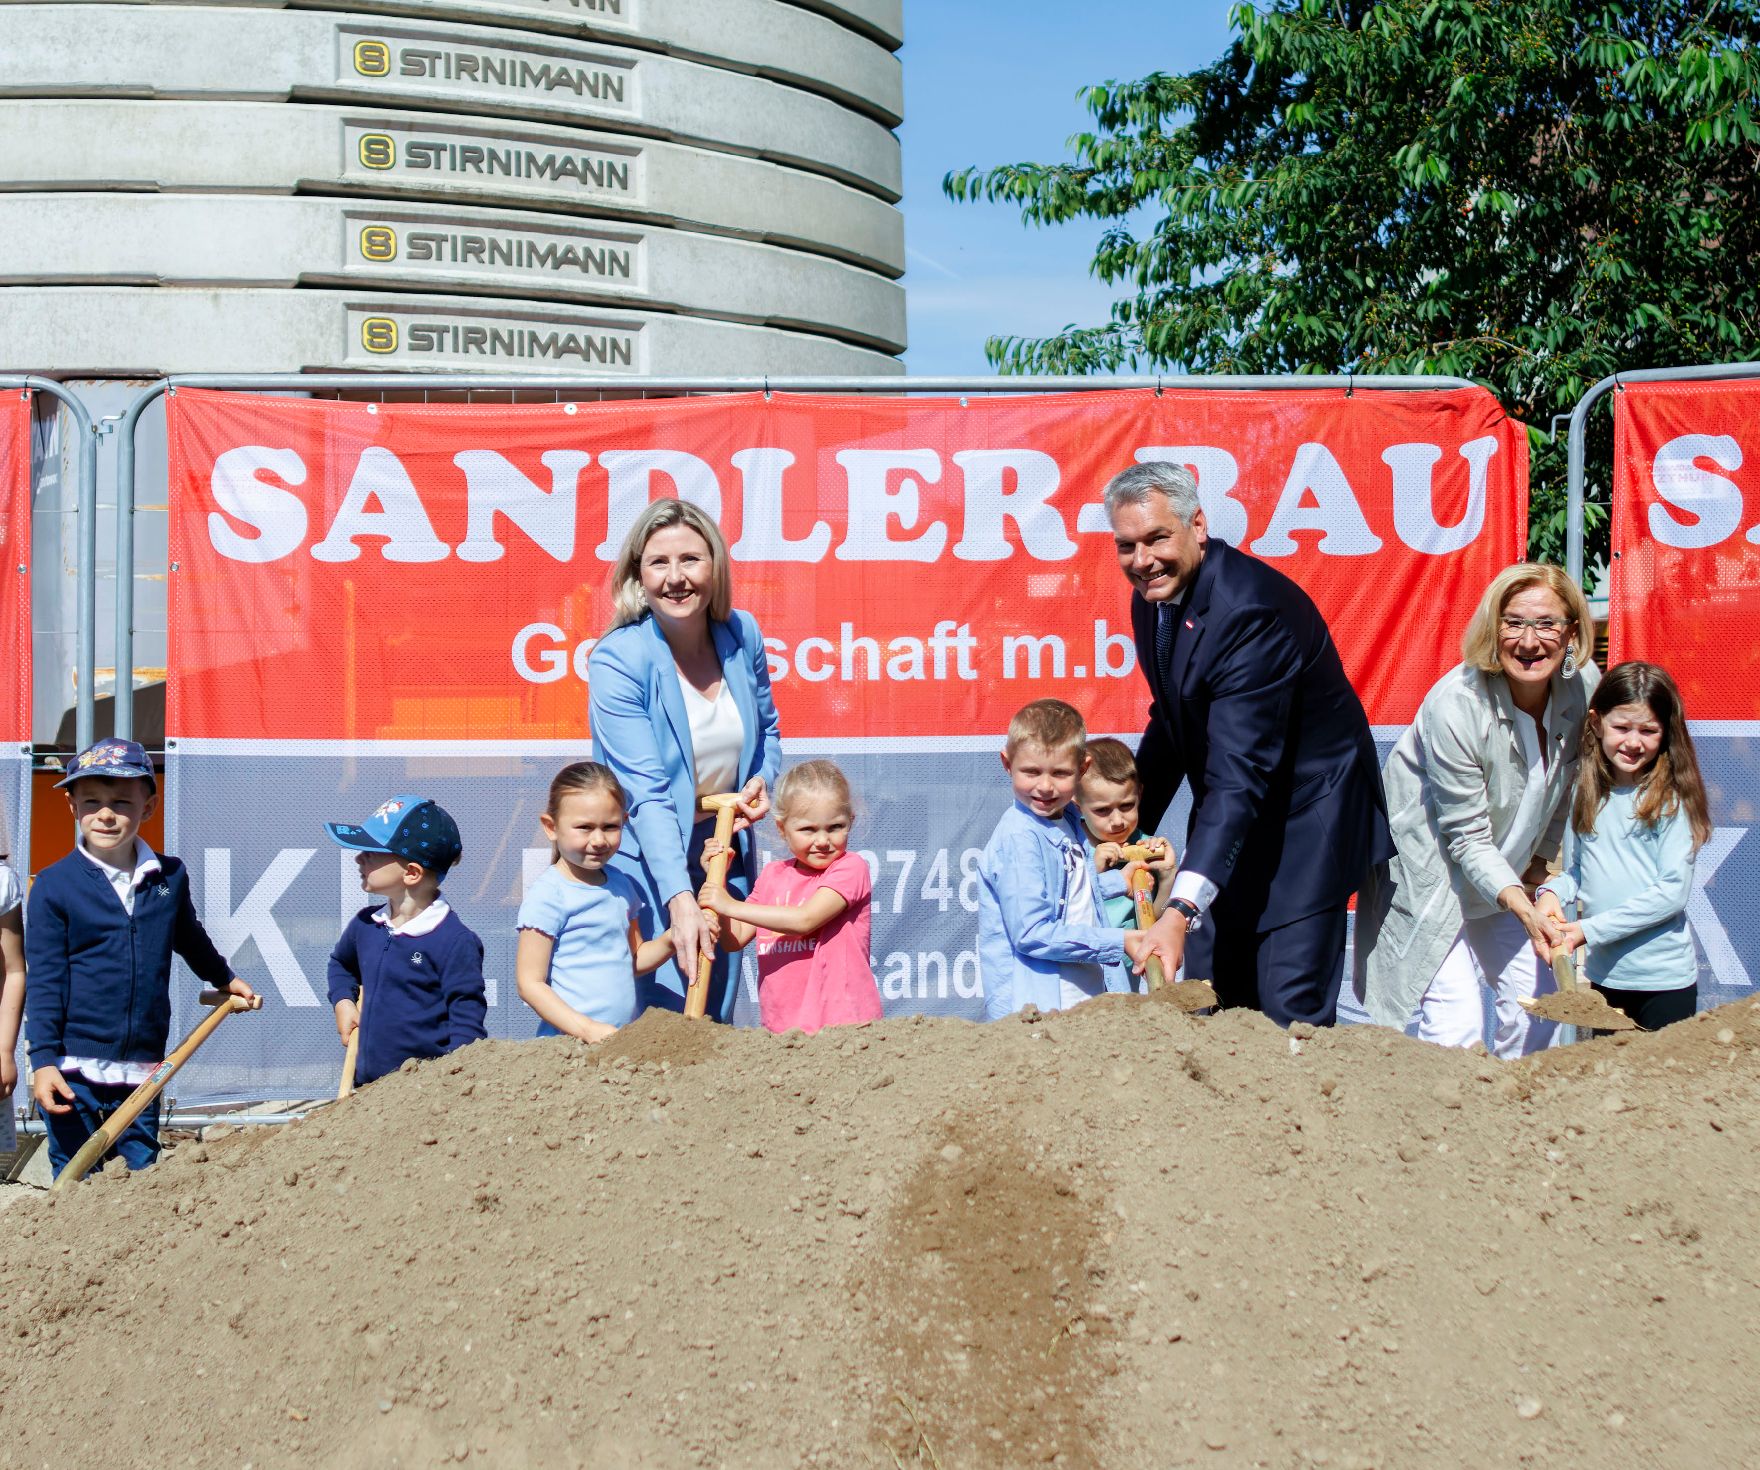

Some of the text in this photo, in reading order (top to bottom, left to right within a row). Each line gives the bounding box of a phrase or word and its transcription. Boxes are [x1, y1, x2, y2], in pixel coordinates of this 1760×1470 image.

[400, 47, 623, 102] STIRNIMANN
[405, 140, 628, 190] STIRNIMANN
[406, 231, 630, 278] STIRNIMANN
[407, 323, 631, 365] STIRNIMANN
[207, 436, 1498, 563] SANDLER-BAU
[1648, 434, 1760, 549] S
[511, 619, 977, 684] Gschaft
